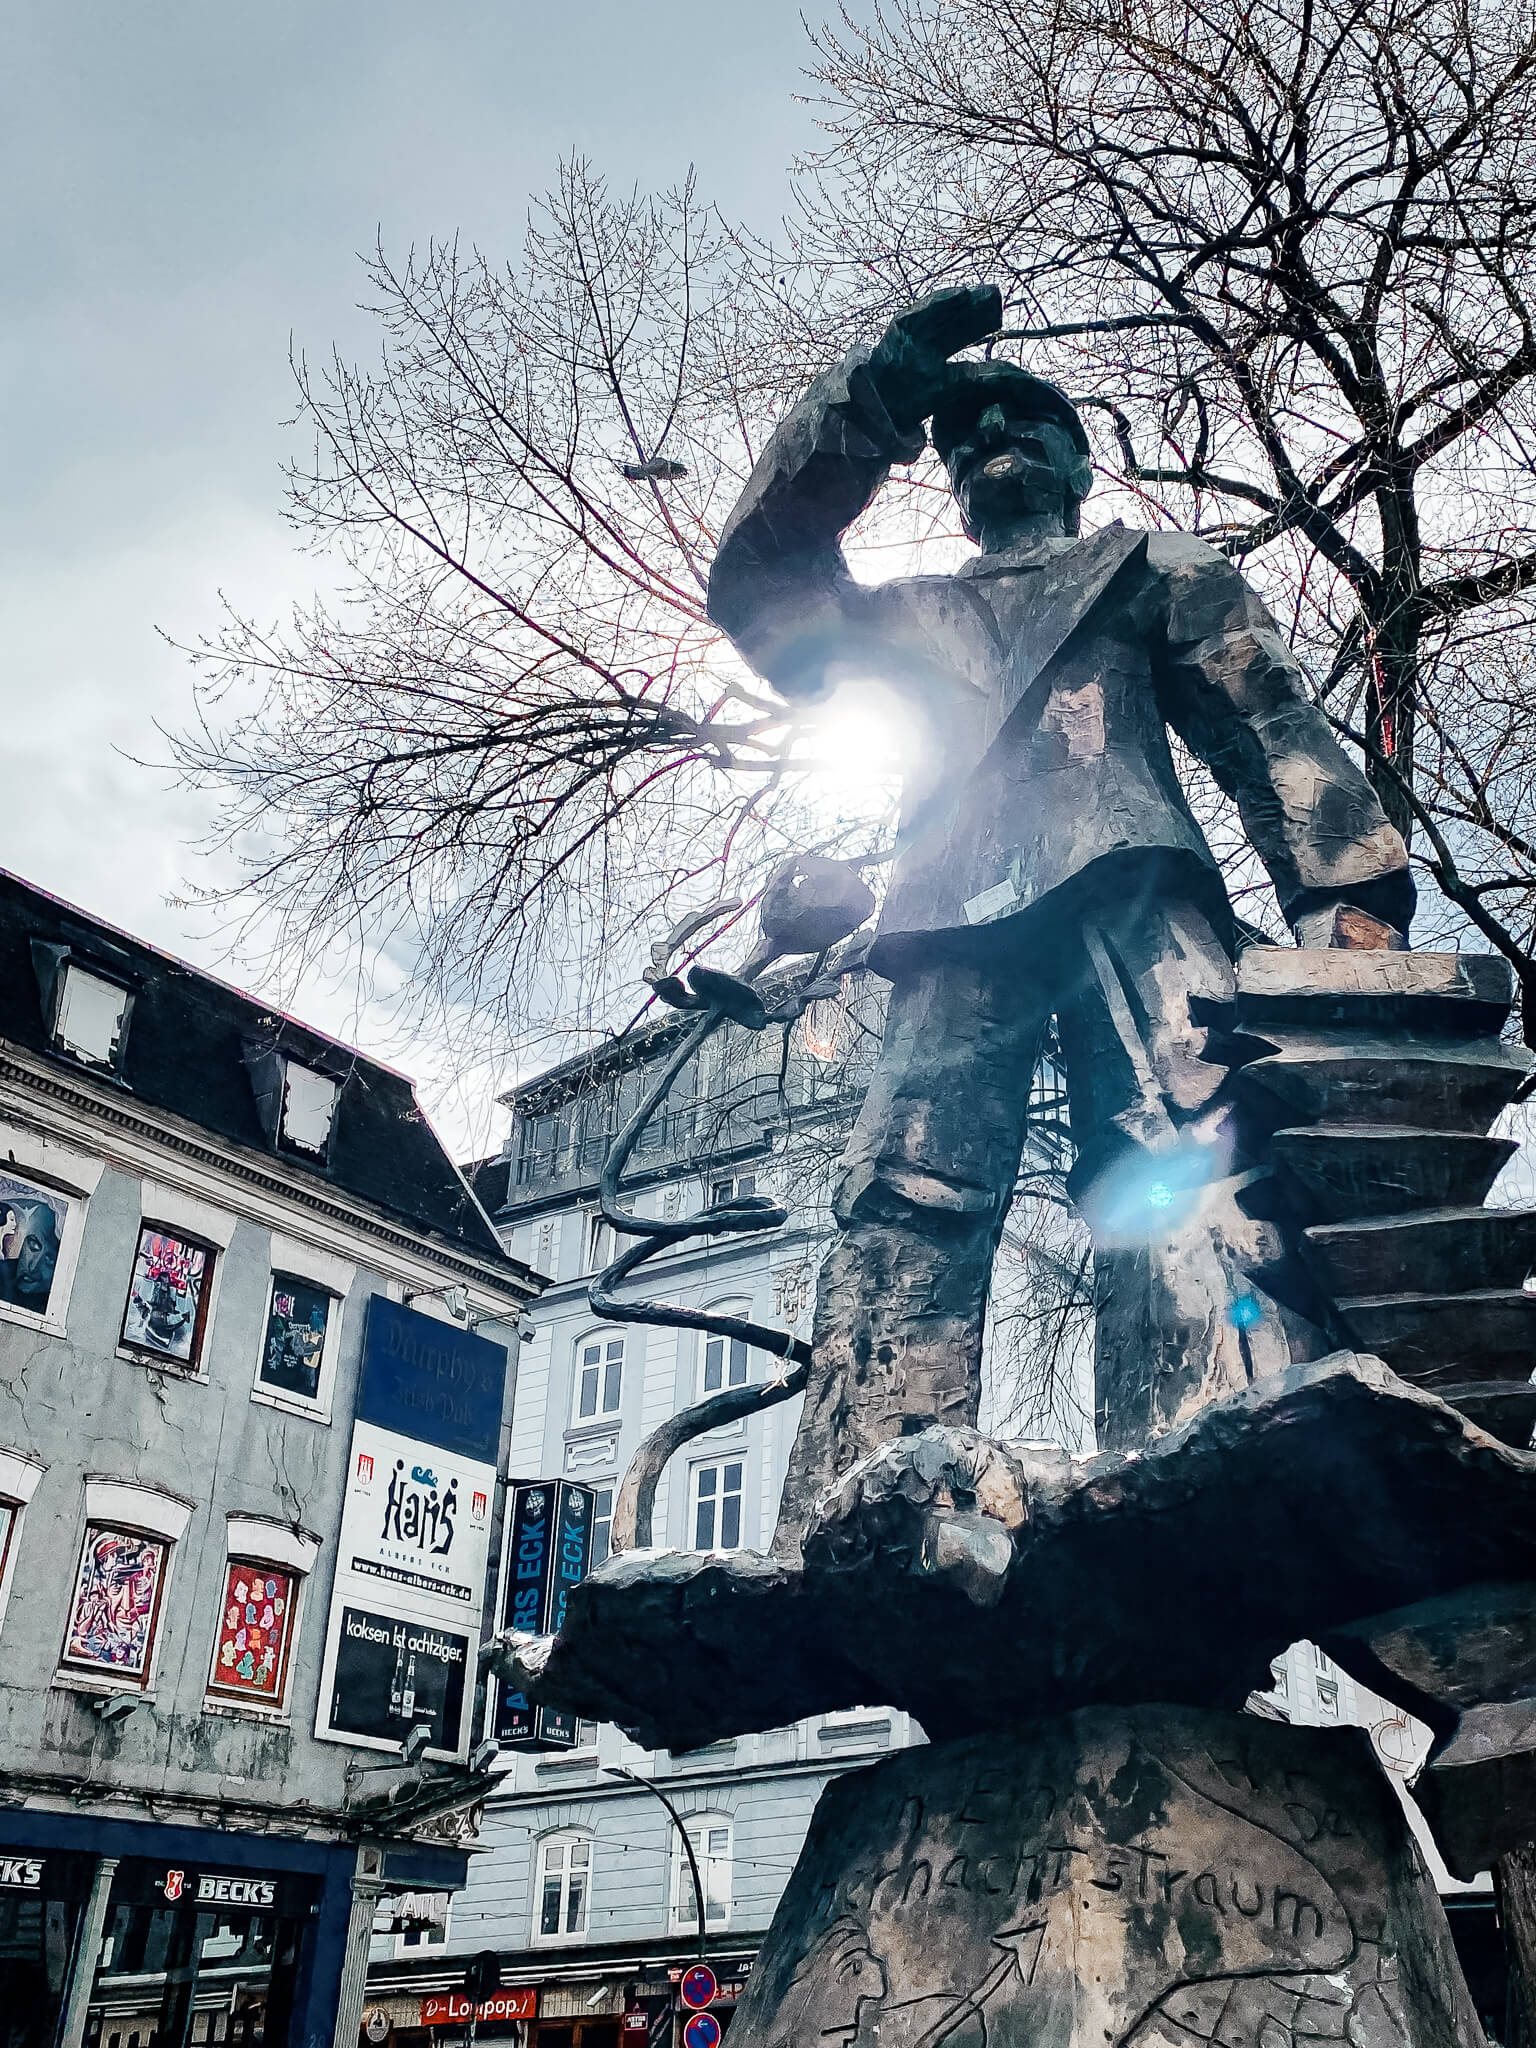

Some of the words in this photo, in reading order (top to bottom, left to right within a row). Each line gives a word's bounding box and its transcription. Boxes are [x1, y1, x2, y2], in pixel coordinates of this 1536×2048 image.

[381, 1459, 458, 1555] Hans
[516, 1517, 545, 1580] ECK
[561, 1520, 586, 1582] ECK
[346, 1614, 390, 1646] koksen
[392, 1625, 407, 1649] ist
[197, 1877, 276, 1904] BECK'S
